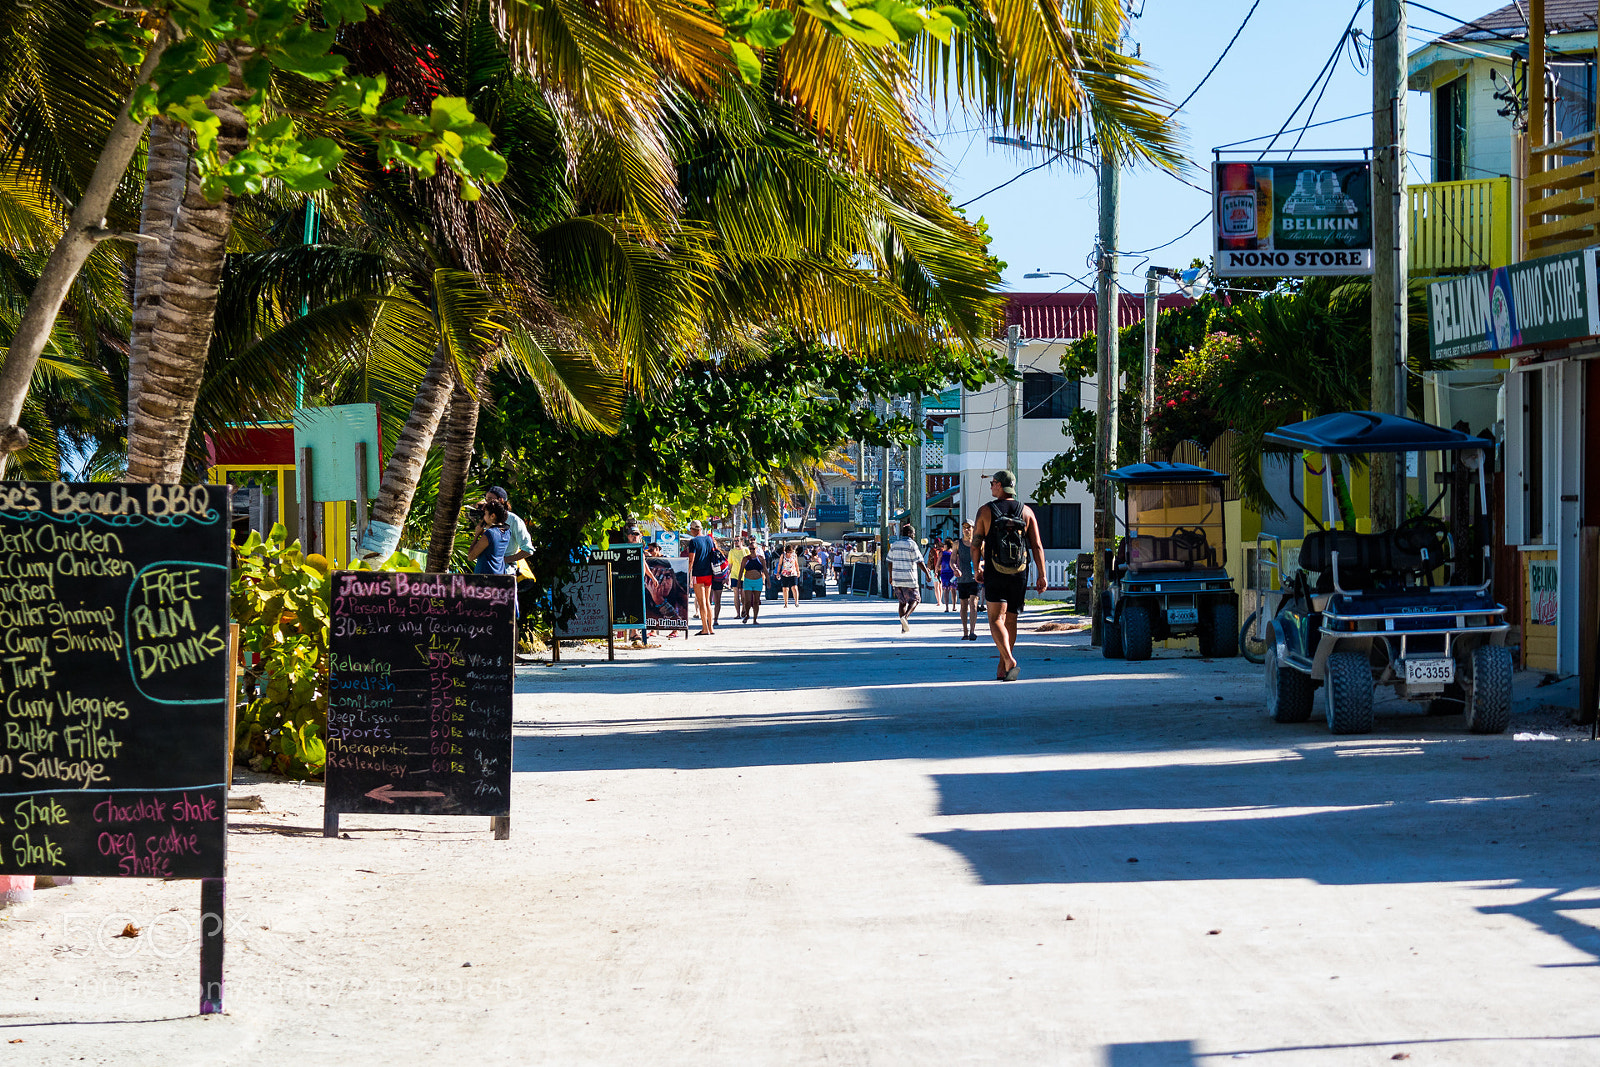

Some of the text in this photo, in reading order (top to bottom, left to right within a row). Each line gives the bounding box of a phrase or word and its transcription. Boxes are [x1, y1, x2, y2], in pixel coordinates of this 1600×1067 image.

[1282, 217, 1358, 230] BELIKIN
[1229, 251, 1362, 267] NONO STORE
[1431, 257, 1583, 345] BELIKIN NONO STORE
[51, 481, 141, 515] Beach
[147, 484, 209, 518] BBQ
[36, 524, 123, 553] Chicken
[57, 552, 136, 578] Chicken
[141, 568, 202, 604] FREE
[339, 573, 515, 606] Javis Beach Massage
[47, 601, 114, 631] Shrimp
[132, 600, 196, 640] RUM
[333, 598, 349, 616] 2
[350, 598, 386, 614] Person
[388, 598, 406, 617] Pay
[409, 597, 431, 615] 50
[335, 617, 356, 637] 30
[398, 621, 423, 636] any
[425, 616, 493, 639] Technique
[52, 627, 123, 660] Shrimp
[134, 625, 225, 679] DRINKS
[3, 656, 56, 689] Turf
[330, 652, 391, 679] Relaxing
[429, 652, 452, 669] 50
[468, 654, 493, 667] Visa
[1415, 666, 1450, 679] C-3355
[330, 673, 396, 694] Swedish
[430, 673, 453, 690] 55
[57, 691, 130, 729] Veggies
[431, 692, 454, 707] 55
[327, 709, 356, 727] Deep
[431, 709, 450, 722] 60
[328, 724, 391, 740] Sports
[431, 724, 450, 738] 60
[5, 722, 122, 759] Butter Fillet
[328, 738, 409, 757] Therapeutic
[431, 741, 450, 755] 60
[19, 752, 111, 790] Sausage
[328, 752, 407, 778] Reflexology
[15, 796, 69, 831] Shake
[12, 833, 66, 867] Shake
